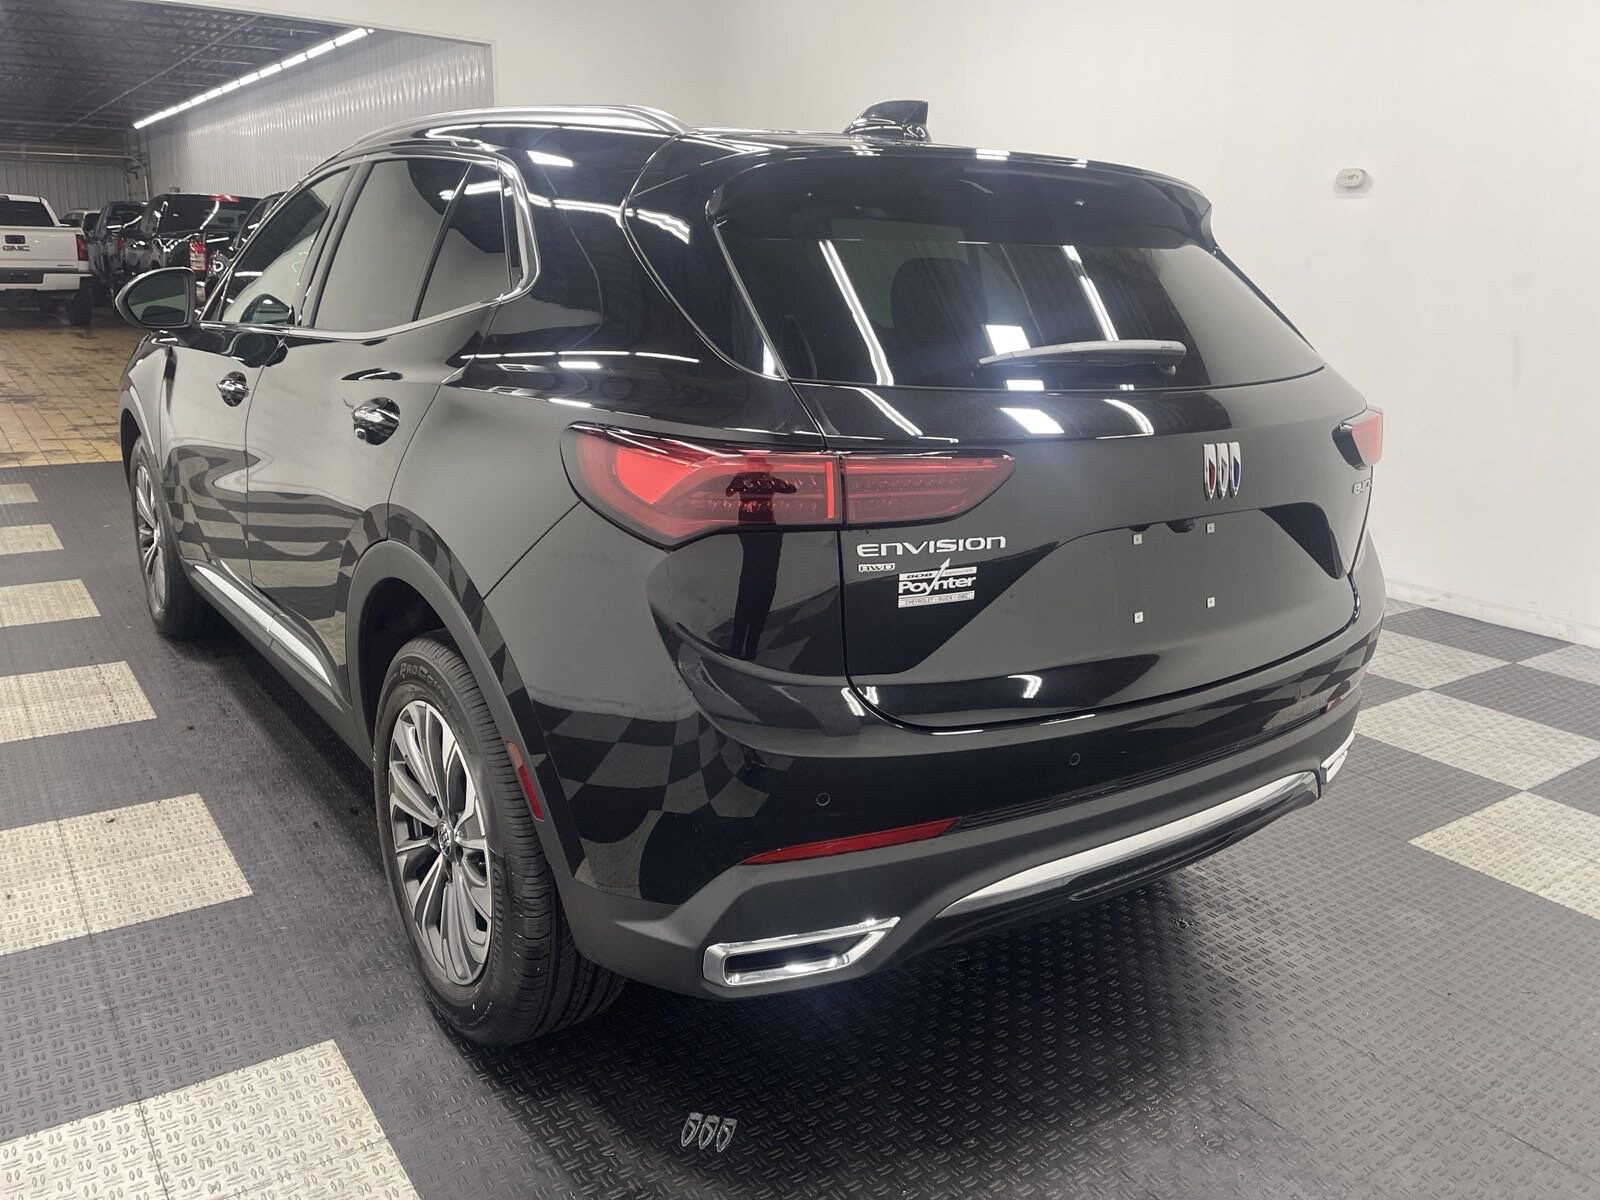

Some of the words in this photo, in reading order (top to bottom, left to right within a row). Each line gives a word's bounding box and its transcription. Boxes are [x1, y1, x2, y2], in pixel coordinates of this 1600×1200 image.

[856, 536, 1006, 557] ENVISION
[858, 562, 895, 572] AWD
[898, 576, 977, 596] Poynter
